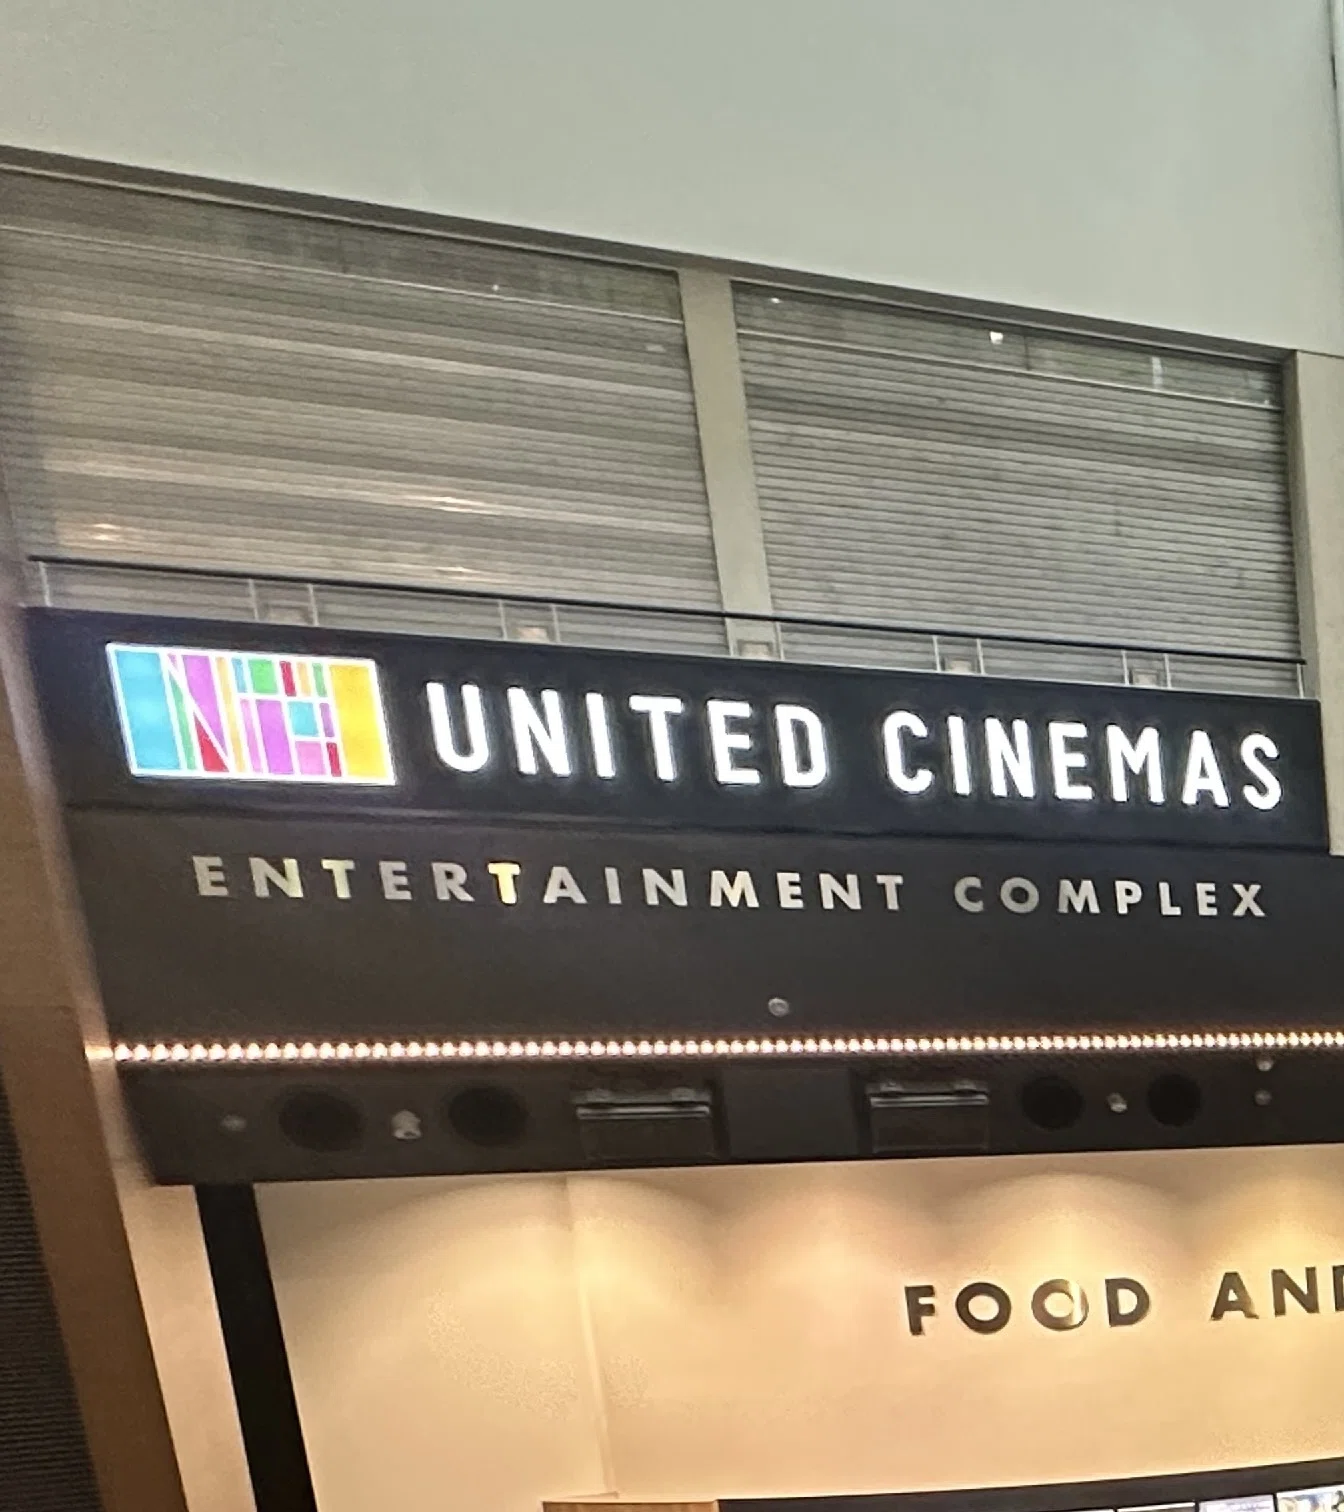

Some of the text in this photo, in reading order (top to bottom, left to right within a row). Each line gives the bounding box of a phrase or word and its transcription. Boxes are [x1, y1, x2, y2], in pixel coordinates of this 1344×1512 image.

[425, 683, 1283, 812] UNITED CINEMAS
[191, 853, 1268, 920] ENTERTAINMENT COMPLEX
[904, 1277, 1151, 1337] FOOD
